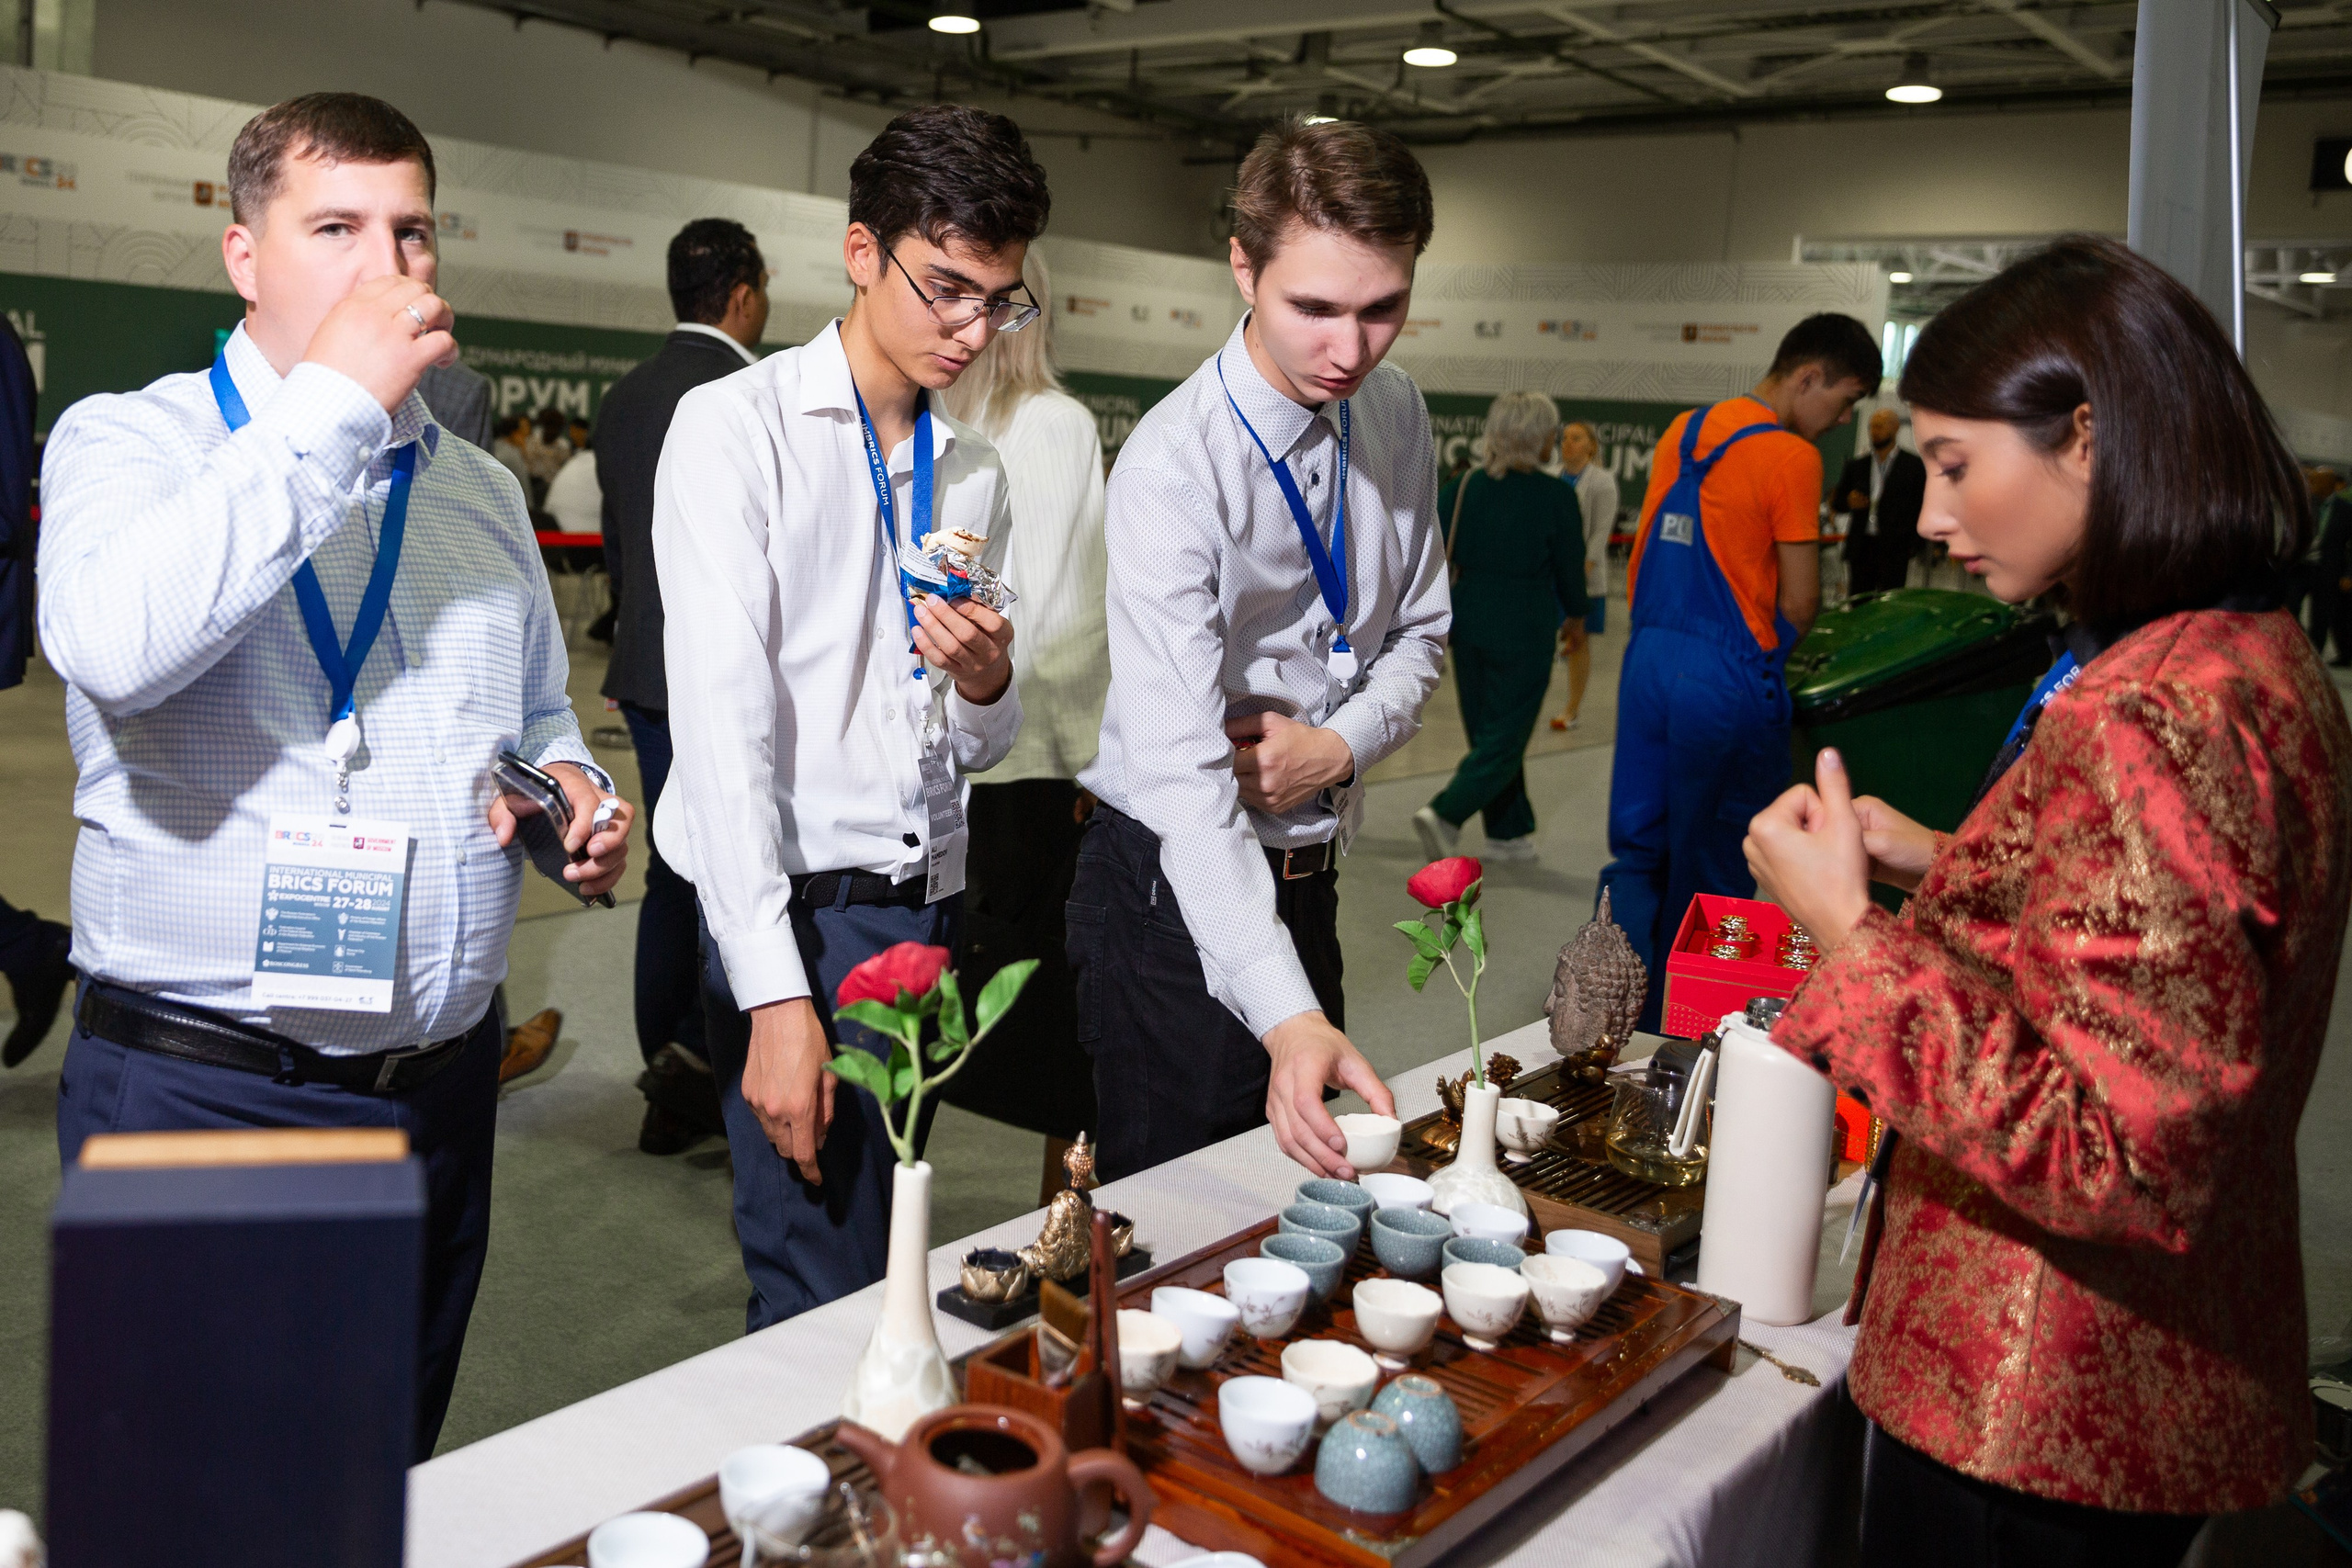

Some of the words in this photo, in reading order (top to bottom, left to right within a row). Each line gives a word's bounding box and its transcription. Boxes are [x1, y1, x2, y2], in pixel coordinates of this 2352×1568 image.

[862, 423, 880, 466] IMBRICS
[876, 467, 889, 506] FORUM
[925, 784, 941, 797] BRICS
[269, 865, 344, 879] INTERNATIONAL
[345, 871, 393, 882] MUNICIPAL
[267, 874, 323, 892] BRICS
[327, 878, 394, 897] FORUM
[278, 893, 331, 903] EXPOCENTRE
[333, 896, 372, 910] 27-28
